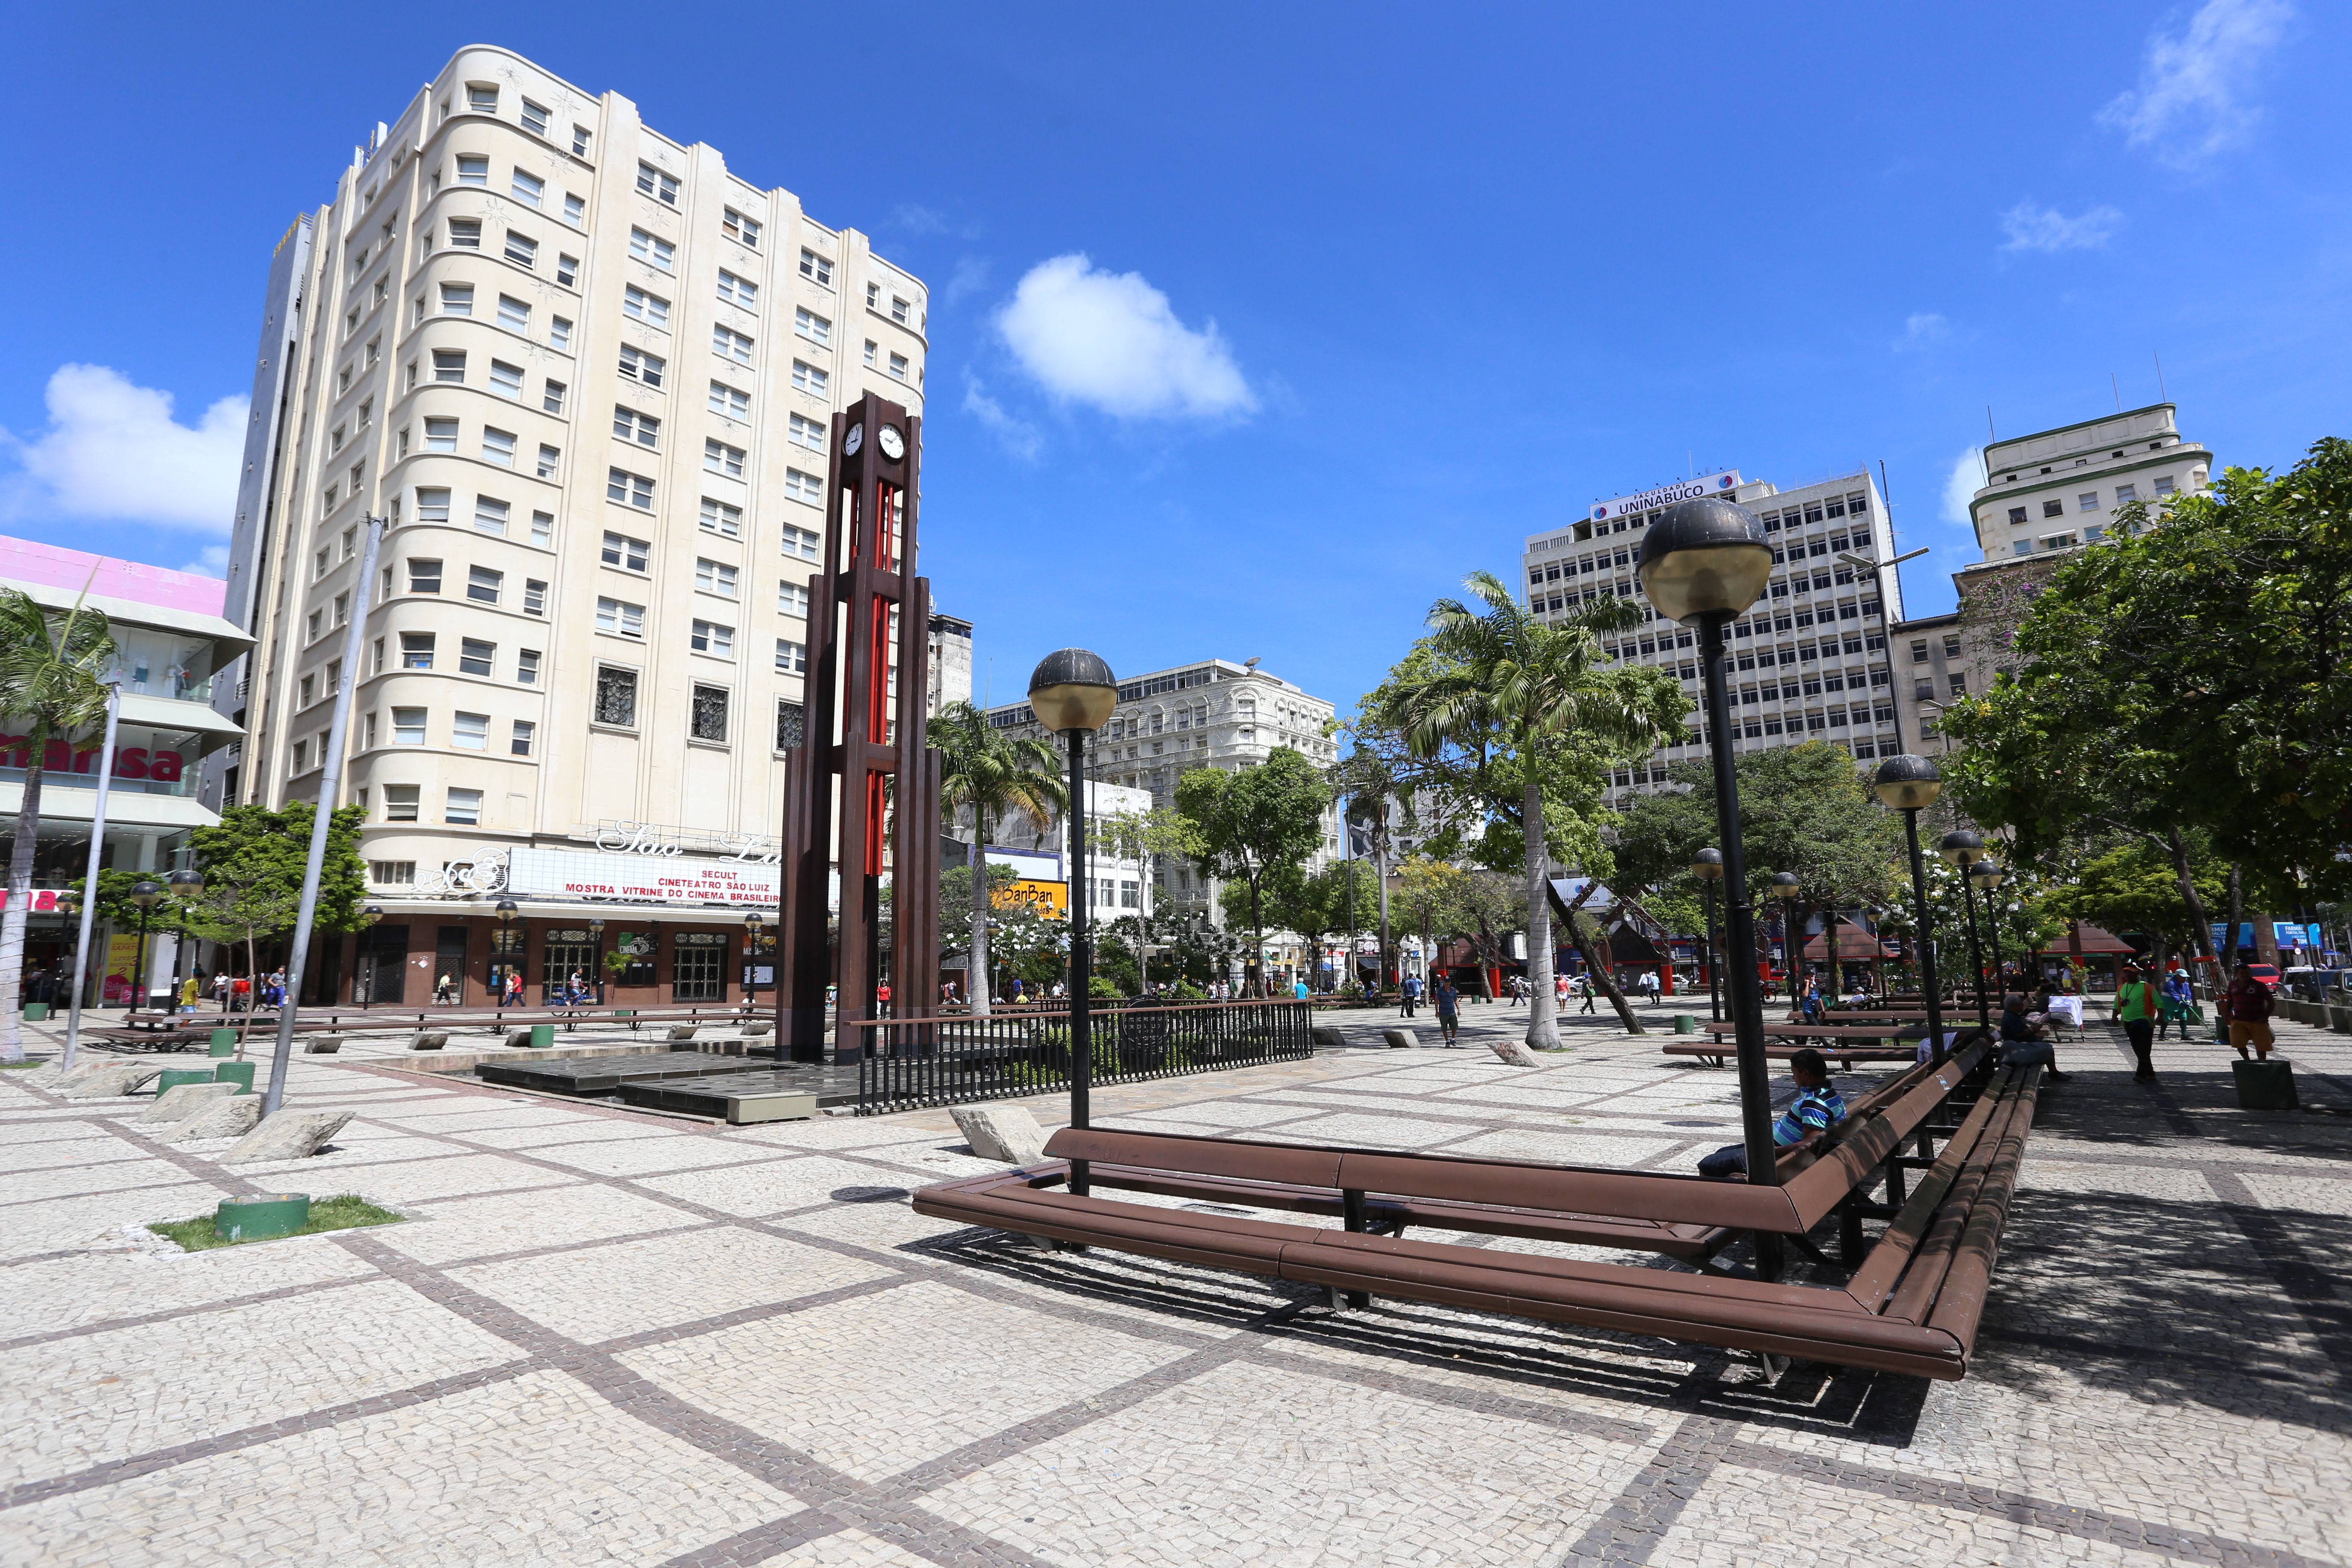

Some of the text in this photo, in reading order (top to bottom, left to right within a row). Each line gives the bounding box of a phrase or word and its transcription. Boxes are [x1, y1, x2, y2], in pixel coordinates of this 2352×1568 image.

[1619, 485, 1703, 514] UNINABUCO
[1634, 483, 1686, 500] FACULDADE
[595, 819, 781, 866] São Lu
[701, 870, 737, 879] SECULT
[566, 883, 614, 894] MOSTRA
[622, 886, 663, 896] VITRINE
[688, 891, 724, 900] CINEMA
[658, 878, 721, 889] CINETEATRO
[727, 880, 746, 890] SÃO
[620, 946, 637, 954] CINEMA
